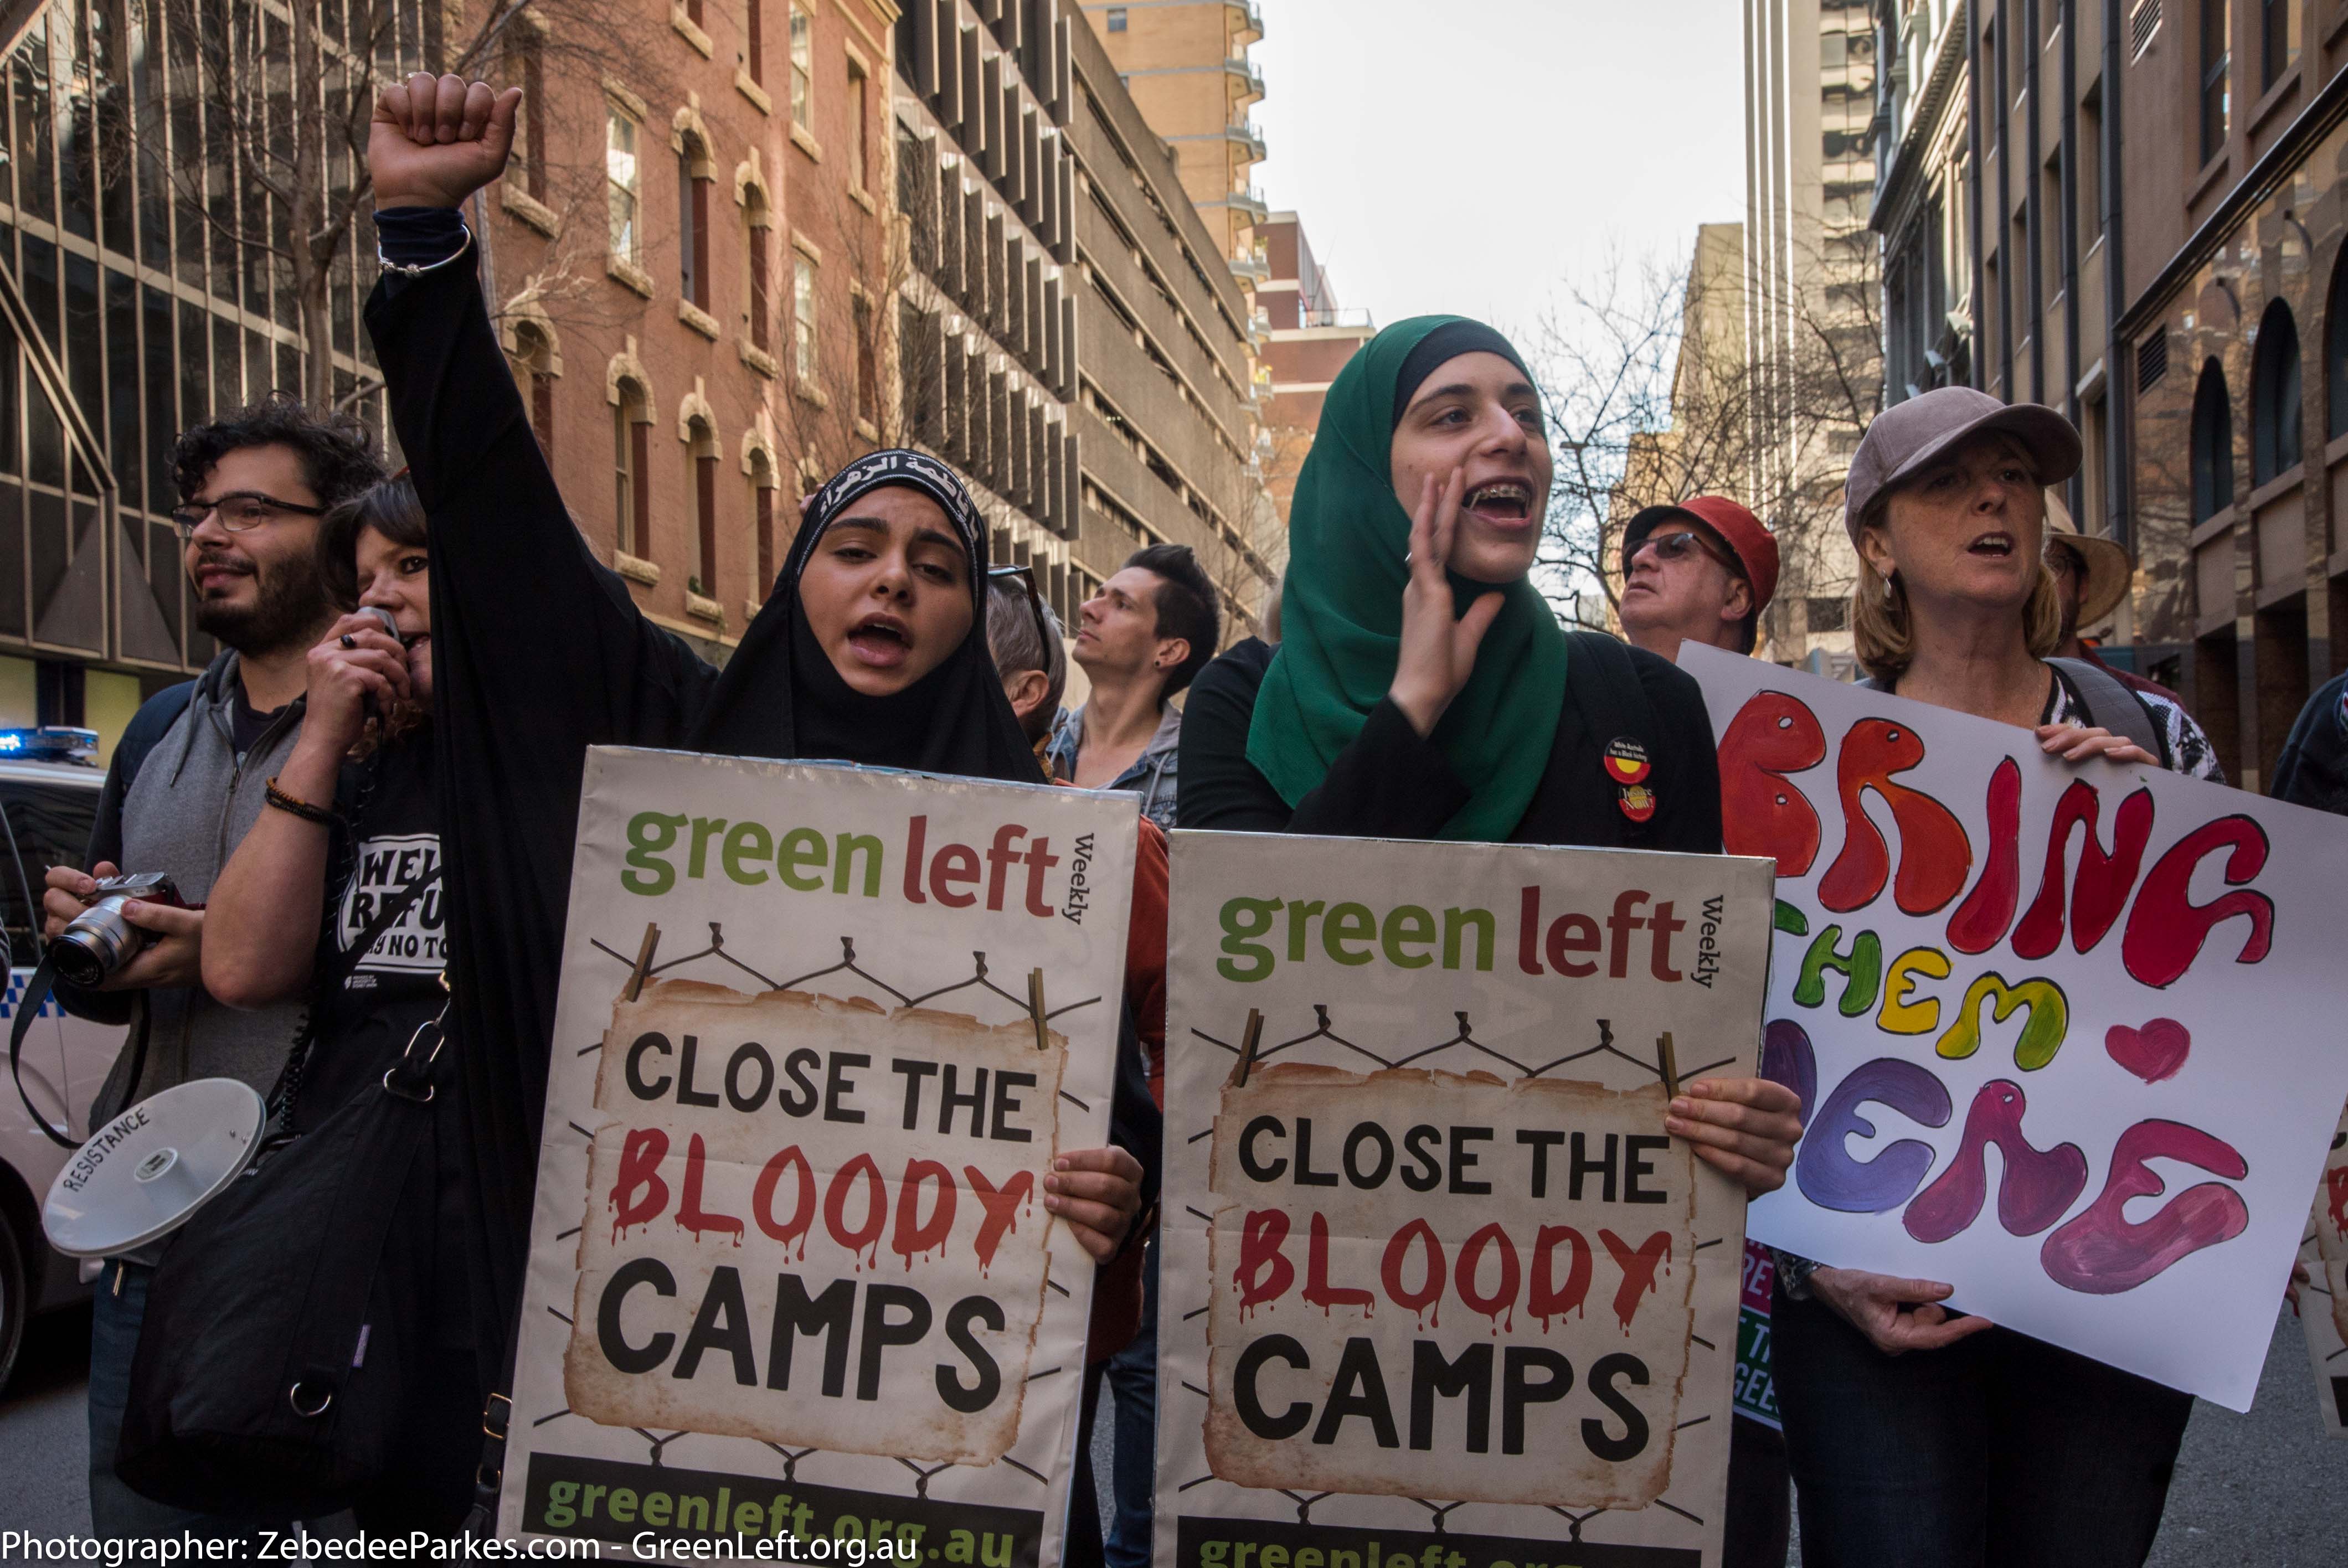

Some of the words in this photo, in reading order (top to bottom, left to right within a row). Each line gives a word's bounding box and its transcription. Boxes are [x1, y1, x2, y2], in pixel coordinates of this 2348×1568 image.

[621, 812, 883, 896] green
[903, 815, 1059, 917] left
[1062, 833, 1094, 925] Weekly
[1717, 689, 2275, 990] BRING
[388, 935, 419, 958] NO
[1217, 897, 1495, 983] green
[1518, 885, 1686, 983] left
[1690, 894, 1724, 989] Weekly
[625, 1031, 871, 1124] CLOSE
[892, 1058, 1037, 1143] THE
[63, 1107, 150, 1193] RESISTANCE
[1238, 1115, 1494, 1195] CLOSE
[1516, 1129, 1670, 1204] THE
[1760, 1018, 2249, 1295] ERE
[608, 1127, 1034, 1279] BLOODY
[1233, 1208, 1672, 1338] BLOODY
[597, 1257, 1005, 1413] CAMPS
[1233, 1333, 1650, 1462] CAMPS
[544, 1481, 1014, 1568] greenleft.org.au
